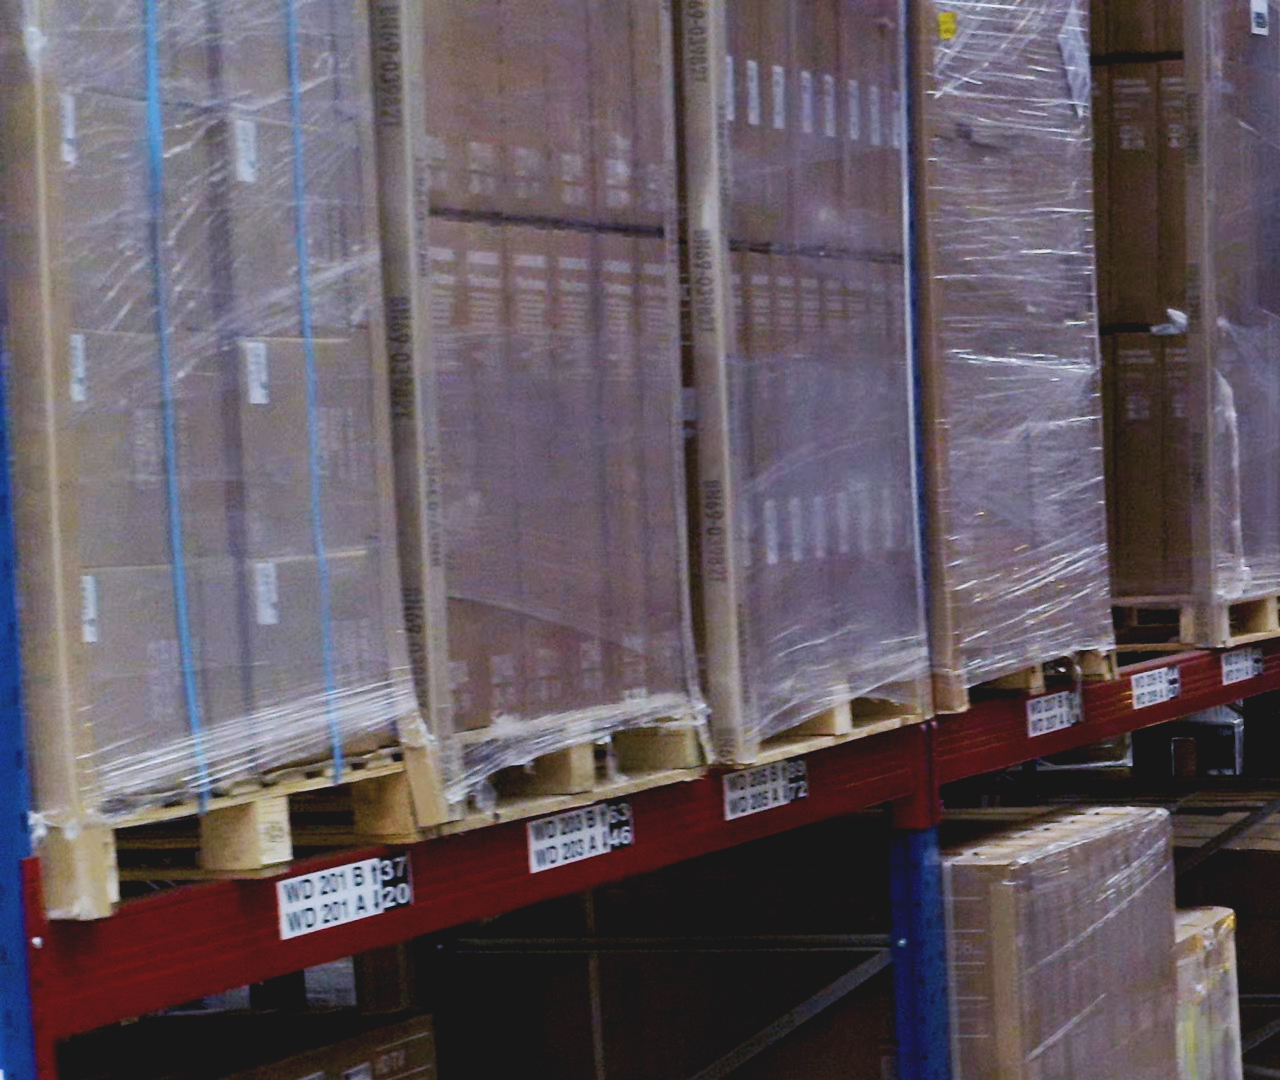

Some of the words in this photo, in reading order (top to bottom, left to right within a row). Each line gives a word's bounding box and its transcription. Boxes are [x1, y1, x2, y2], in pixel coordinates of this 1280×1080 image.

[534, 845, 559, 868] WD
[283, 878, 315, 904] WD
[320, 869, 347, 896] 201
[352, 866, 366, 887] B
[286, 906, 317, 932] WD
[321, 898, 349, 924] 201
[355, 894, 368, 916] A
[382, 882, 411, 909] 20
